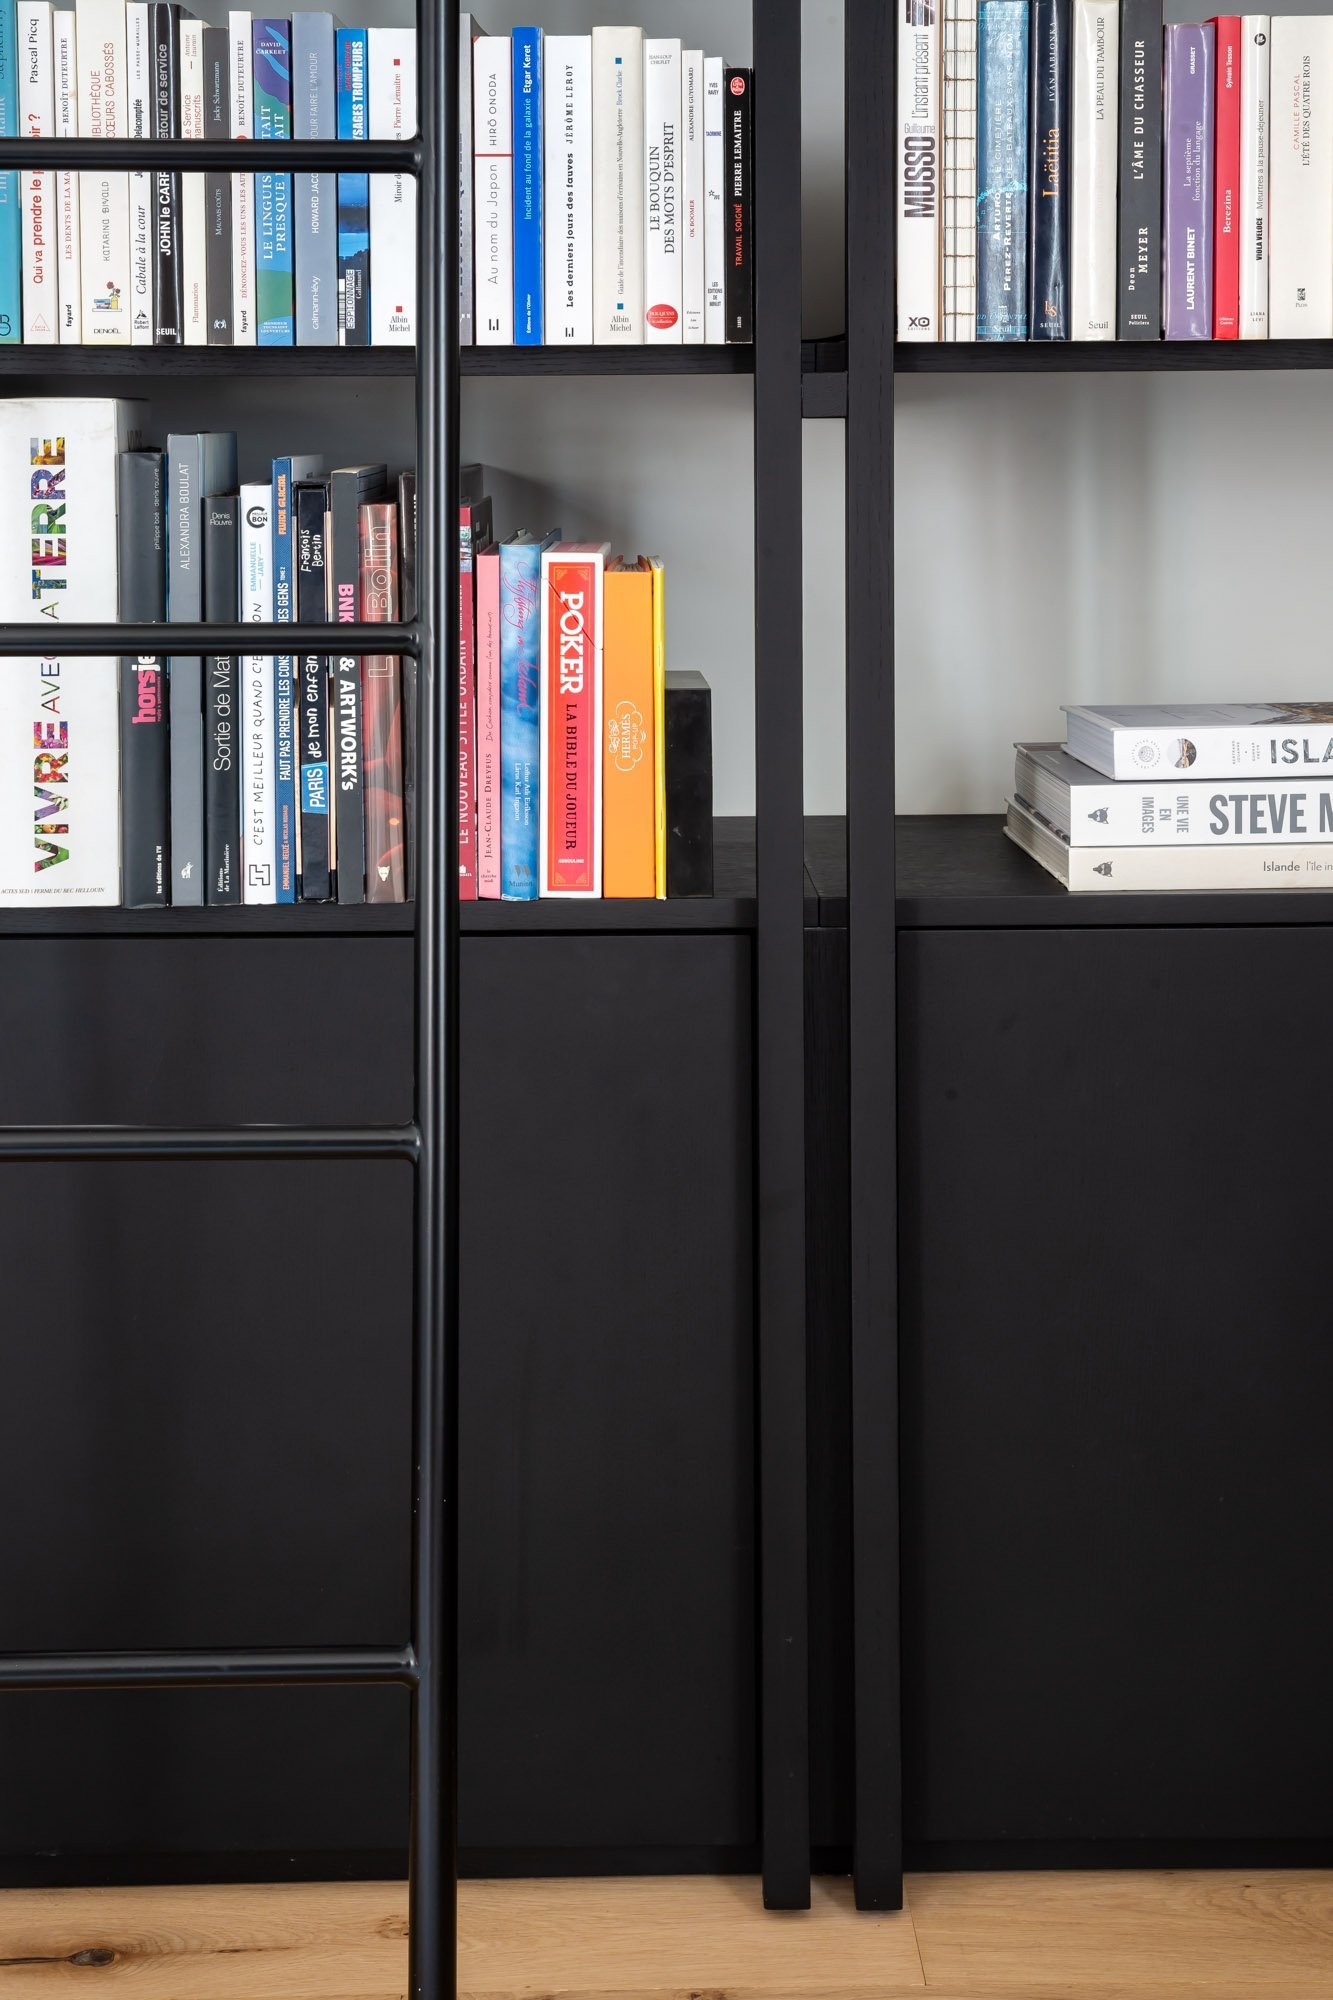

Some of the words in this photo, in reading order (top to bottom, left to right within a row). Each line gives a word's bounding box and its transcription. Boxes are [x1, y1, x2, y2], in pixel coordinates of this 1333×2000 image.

[28, 18, 40, 43] Picq
[1096, 17, 1105, 63] TAMBOUR
[29, 47, 39, 83] Pascal
[102, 42, 114, 96] CABOSSÉS
[157, 44, 168, 87] service
[522, 45, 531, 68] Keret
[913, 34, 931, 74] présent
[1302, 56, 1310, 78] ROIS
[352, 42, 363, 102] TROMPEURS
[523, 70, 533, 93] Etgar
[565, 64, 573, 98] LEROY
[1096, 66, 1104, 79] DU
[1134, 40, 1144, 110] CHASSEUR
[60, 92, 70, 123] BENOÎT
[157, 90, 167, 102] de
[182, 94, 192, 127] Service
[236, 94, 245, 126] BENOÎT
[1302, 80, 1311, 118] QUATRE
[394, 107, 402, 129] Pierre
[523, 98, 533, 128] galaxie
[564, 102, 573, 144] JÉRÔME
[1096, 109, 1104, 120] LA
[1134, 117, 1144, 134] DU
[1256, 100, 1265, 158] pause-déjeuner
[1302, 121, 1310, 138] DES
[523, 141, 532, 150] de
[734, 110, 742, 160] LEMAITRE
[1193, 121, 1203, 152] langage
[523, 154, 532, 172] fond
[663, 122, 674, 182] D'ESPRIT
[1042, 128, 1060, 197] Laëtitia
[1132, 141, 1144, 179] L'ÂME
[1184, 138, 1194, 174] septième
[1193, 155, 1201, 165] du
[31, 180, 42, 190] le
[64, 187, 71, 198] LA
[488, 164, 500, 206] Japon
[526, 175, 532, 184] au
[649, 146, 661, 212] BOUQUIN
[734, 162, 742, 196] PIERRE
[904, 137, 935, 218] MUSSO
[1184, 176, 1192, 186] La
[1193, 168, 1201, 201] fonction
[32, 194, 45, 245] prendre
[65, 201, 71, 212] DE
[159, 207, 170, 217] le
[275, 182, 286, 251] PRESQUE
[311, 197, 320, 233] HOWARD
[487, 211, 498, 228] du
[524, 188, 532, 220] Incident
[664, 186, 674, 225] MOTS
[733, 203, 742, 232] SOIGNÉ
[1223, 190, 1232, 233] Berezina
[136, 224, 146, 234] la
[160, 220, 171, 256] JOHN
[566, 213, 575, 240] jours
[650, 214, 660, 231] LE
[35, 250, 43, 262] va
[264, 243, 272, 259] LE
[664, 228, 675, 254] DES
[1002, 193, 1012, 291] PÉREZ-REVERTE
[1138, 227, 1148, 274] MEYER
[1186, 227, 1196, 258] BINET
[33, 266, 44, 284] Qui
[135, 249, 147, 294] Cabale
[487, 266, 498, 284] Au
[1186, 262, 1196, 310] LAURENT
[66, 305, 74, 327] fayard
[389, 324, 410, 332] Michel
[1088, 321, 1109, 329] Seuil
[179, 463, 190, 503] BOULAT
[278, 474, 286, 507] GLACIAL
[30, 437, 66, 599] TERRE
[278, 510, 286, 535] FLUIDE
[180, 507, 190, 570] ALEXANDRA
[301, 530, 313, 572] François
[312, 534, 323, 566] Bertin
[364, 526, 392, 615] Bolin
[277, 583, 288, 606] GENS
[560, 591, 583, 693] POKER
[252, 681, 265, 727] QUAND
[277, 680, 290, 695] LES
[213, 694, 230, 717] de
[277, 698, 290, 738] PRENDRE
[566, 704, 577, 722] LA
[306, 708, 318, 738] mon
[340, 679, 358, 791] ARTWORK's
[619, 713, 631, 758] HERMÈS
[213, 724, 231, 771] Sortie
[278, 741, 291, 756] PAS
[306, 742, 323, 759] de
[566, 726, 577, 768] BIBLE
[252, 733, 264, 802] MEILLEUR
[278, 759, 291, 780] FAUT
[566, 772, 577, 790] DU
[32, 721, 69, 873] VIVRE
[306, 768, 326, 808] PARIS
[459, 750, 468, 823] NOUVEAU
[566, 794, 577, 850] JOUEUR
[1141, 797, 1154, 833] IMAGES
[1159, 808, 1171, 821] EN
[1176, 796, 1189, 815] UNE
[1209, 794, 1307, 835] STEVE
[252, 809, 264, 846] C'EST
[484, 798, 493, 858] JEAN-CLAUDE
[1176, 817, 1189, 833] VIE
[1263, 862, 1300, 872] Islande
